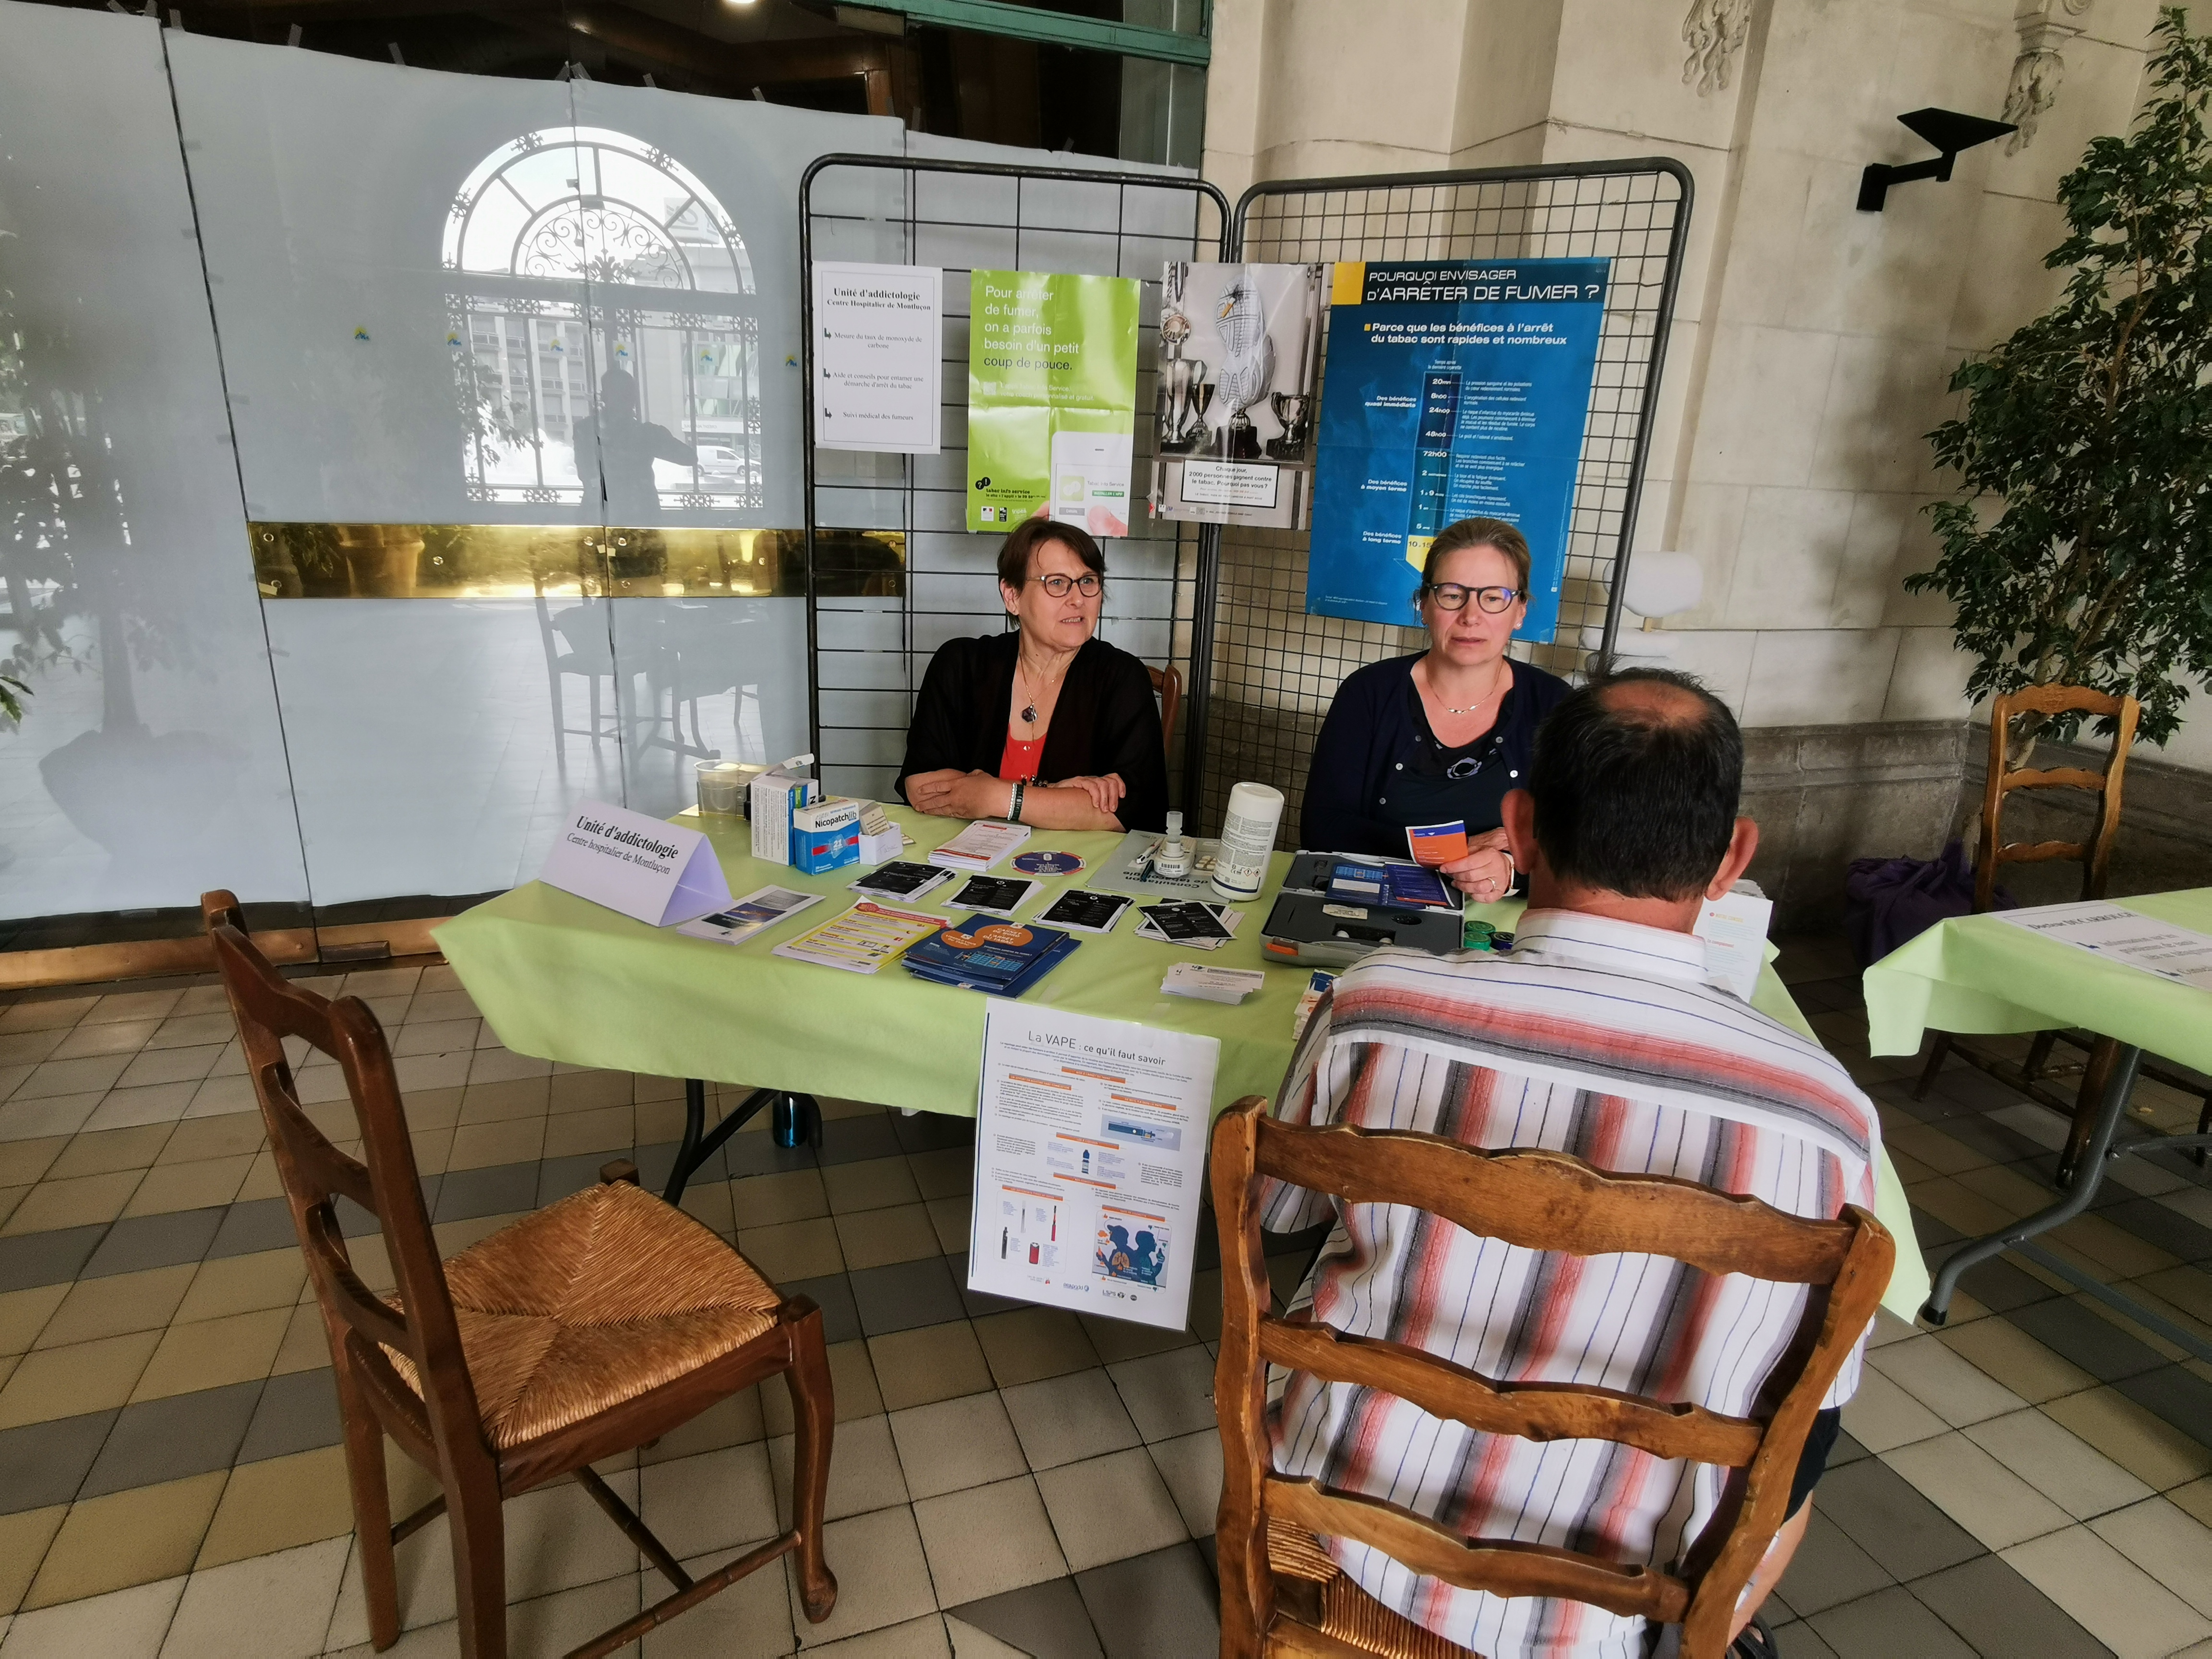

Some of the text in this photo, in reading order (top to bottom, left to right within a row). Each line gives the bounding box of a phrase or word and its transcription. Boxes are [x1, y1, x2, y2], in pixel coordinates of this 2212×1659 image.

[1369, 270, 1516, 282] POURQUOI ENVISAGER
[834, 288, 920, 301] Unité d'addictologie
[986, 285, 1012, 298] Pour
[1367, 281, 1600, 301] D'ARRÊTER DE FUMER ?
[851, 300, 886, 308] Hospitalier
[897, 302, 930, 311] Montluçon
[985, 303, 1039, 319] de fumer,
[985, 323, 1052, 336] on a parfois
[1372, 322, 1553, 334] Parce que les bénéfices à l'arrêt
[984, 337, 1079, 356] besoin d'un petit
[1371, 334, 1567, 346] du tabac sont rapides et nombreux
[984, 357, 1072, 371] coup de pouce.
[844, 380, 870, 388] démarche
[815, 811, 857, 828] Nicopatchlib
[577, 816, 679, 859] Unité d'addictologie
[833, 839, 843, 848] 21
[567, 832, 671, 875] Centre hospitalier de Montluçon
[1123, 871, 1190, 882] tabacolgie
[1125, 876, 1200, 889] Consultaon
[1029, 1031, 1041, 1042] La
[1046, 1034, 1076, 1049] VAPE
[1096, 1047, 1116, 1057] qu'il
[1118, 1050, 1136, 1060] faut
[1138, 1054, 1166, 1066] savoir
